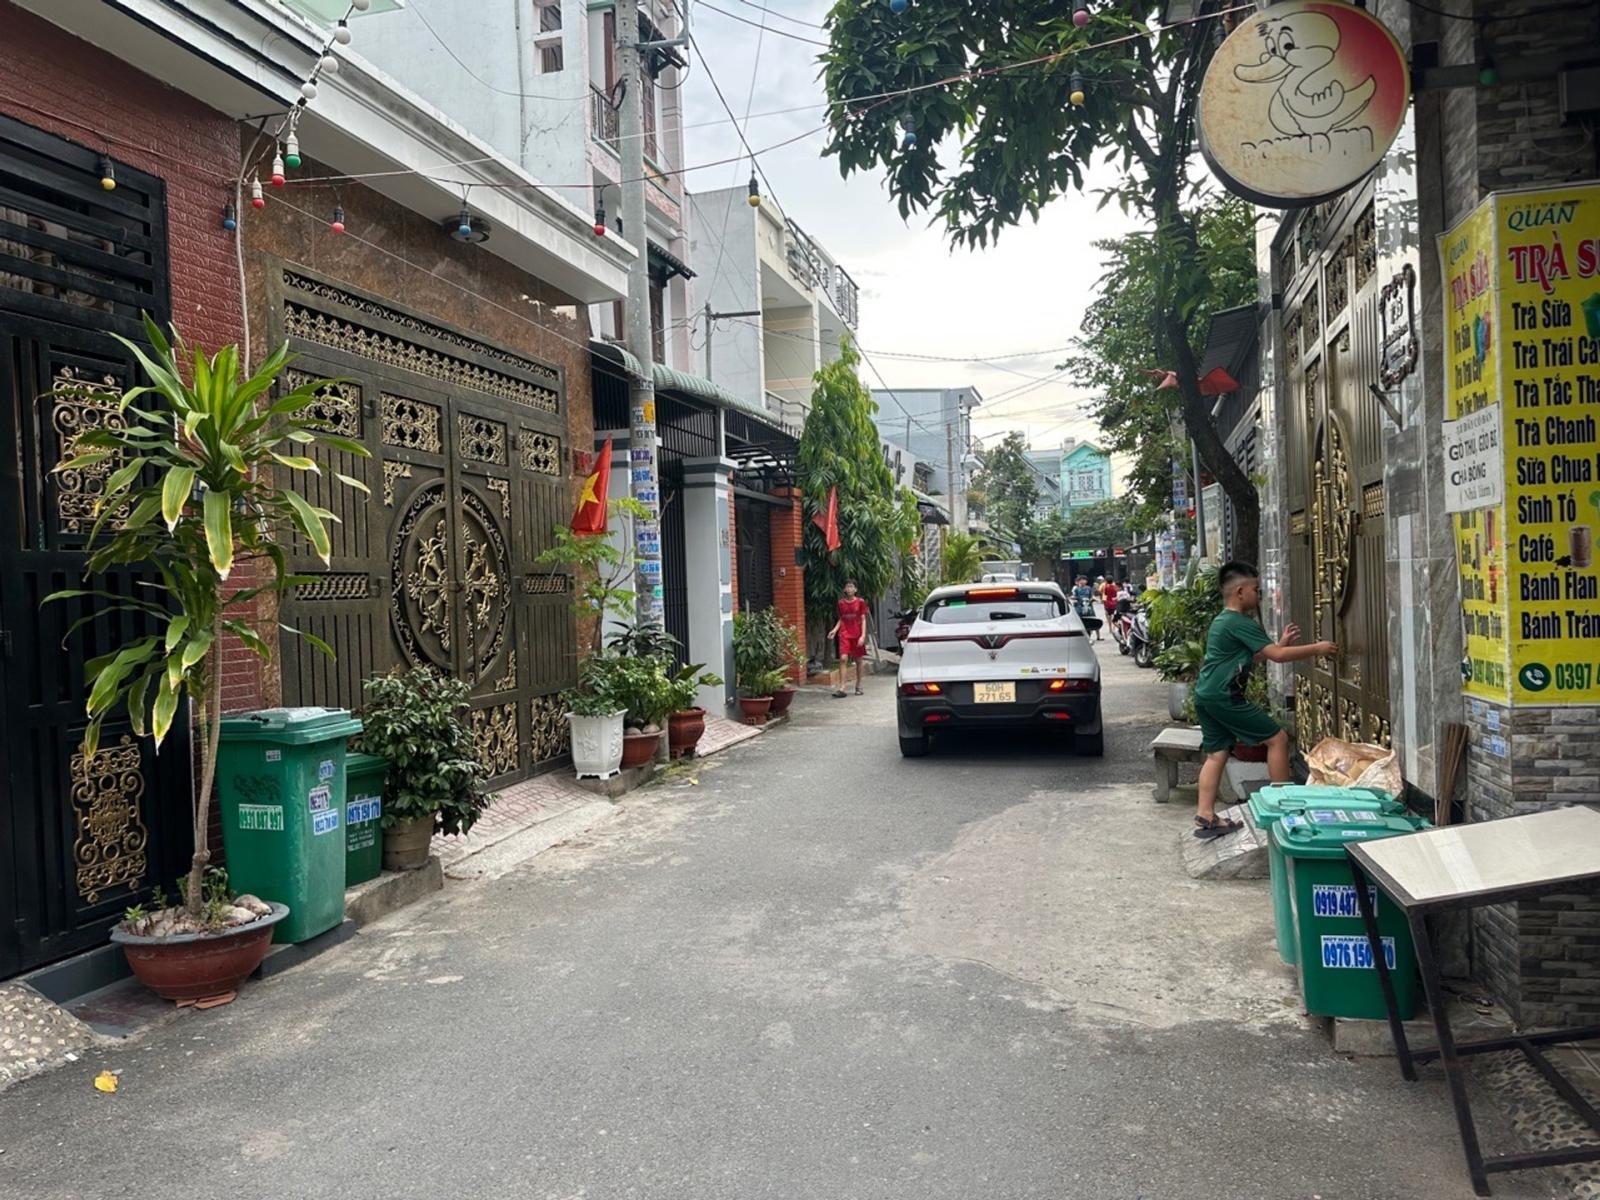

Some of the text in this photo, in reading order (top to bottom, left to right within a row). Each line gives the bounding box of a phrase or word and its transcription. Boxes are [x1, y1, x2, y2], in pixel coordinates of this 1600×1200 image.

[1507, 230, 1571, 294] TRÀ
[1512, 299, 1572, 330] Trà Sữa
[1513, 339, 1538, 369] Trà
[1542, 337, 1573, 367] Trái
[1514, 378, 1539, 408] Trà
[1544, 373, 1572, 406] Tắc
[1515, 414, 1596, 446] Trà Chanh
[1516, 456, 1546, 486] Sữa
[1551, 454, 1591, 484] Chua
[1518, 488, 1576, 524] Sinh Tố
[1519, 533, 1554, 563] Café
[1520, 571, 1598, 601] Bánh Flan
[1521, 611, 1561, 640] Bánh
[1555, 663, 1592, 690] 0397
